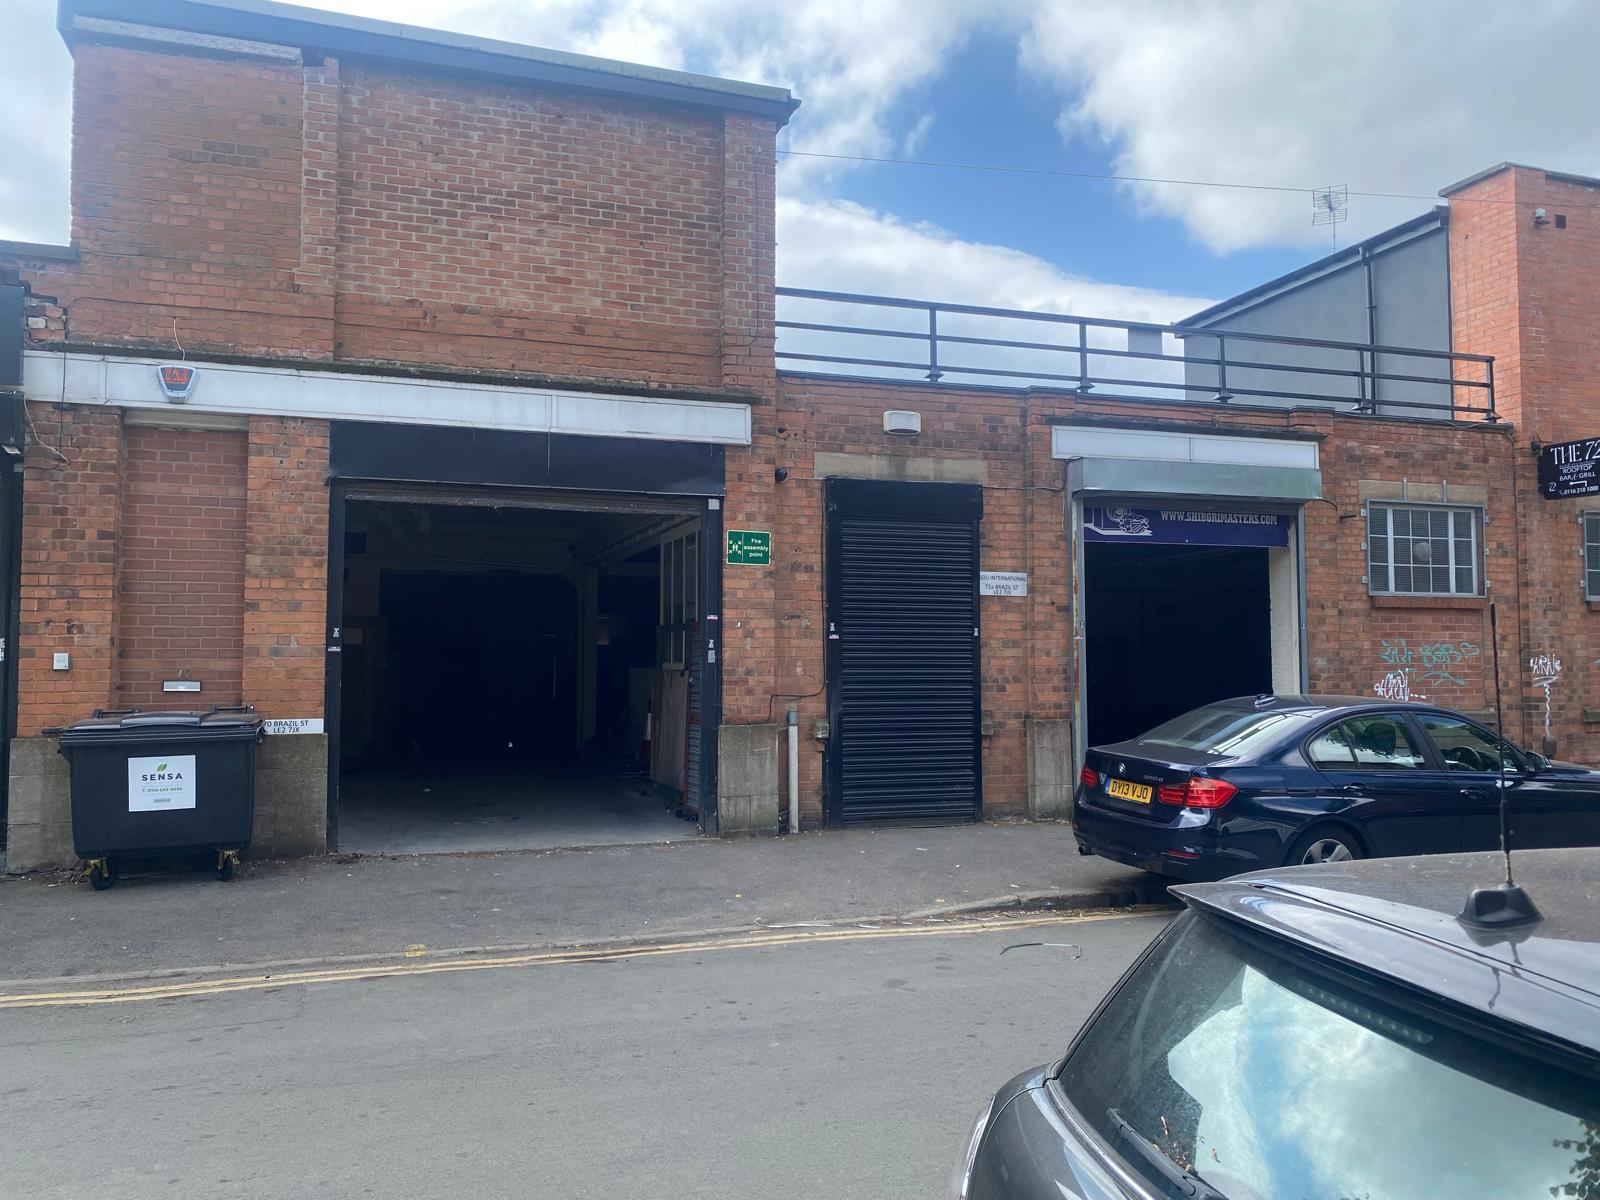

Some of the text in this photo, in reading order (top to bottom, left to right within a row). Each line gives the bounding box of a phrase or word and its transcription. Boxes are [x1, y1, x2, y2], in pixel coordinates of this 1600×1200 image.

[1550, 443, 1582, 465] THE
[1562, 465, 1593, 474] ROOFTOP
[1160, 511, 1278, 525] WWW.SHIBORIMASTERS.COM
[288, 726, 300, 734] 7JX
[141, 773, 183, 782] SENSA
[1111, 780, 1149, 800] DY13 VJO
